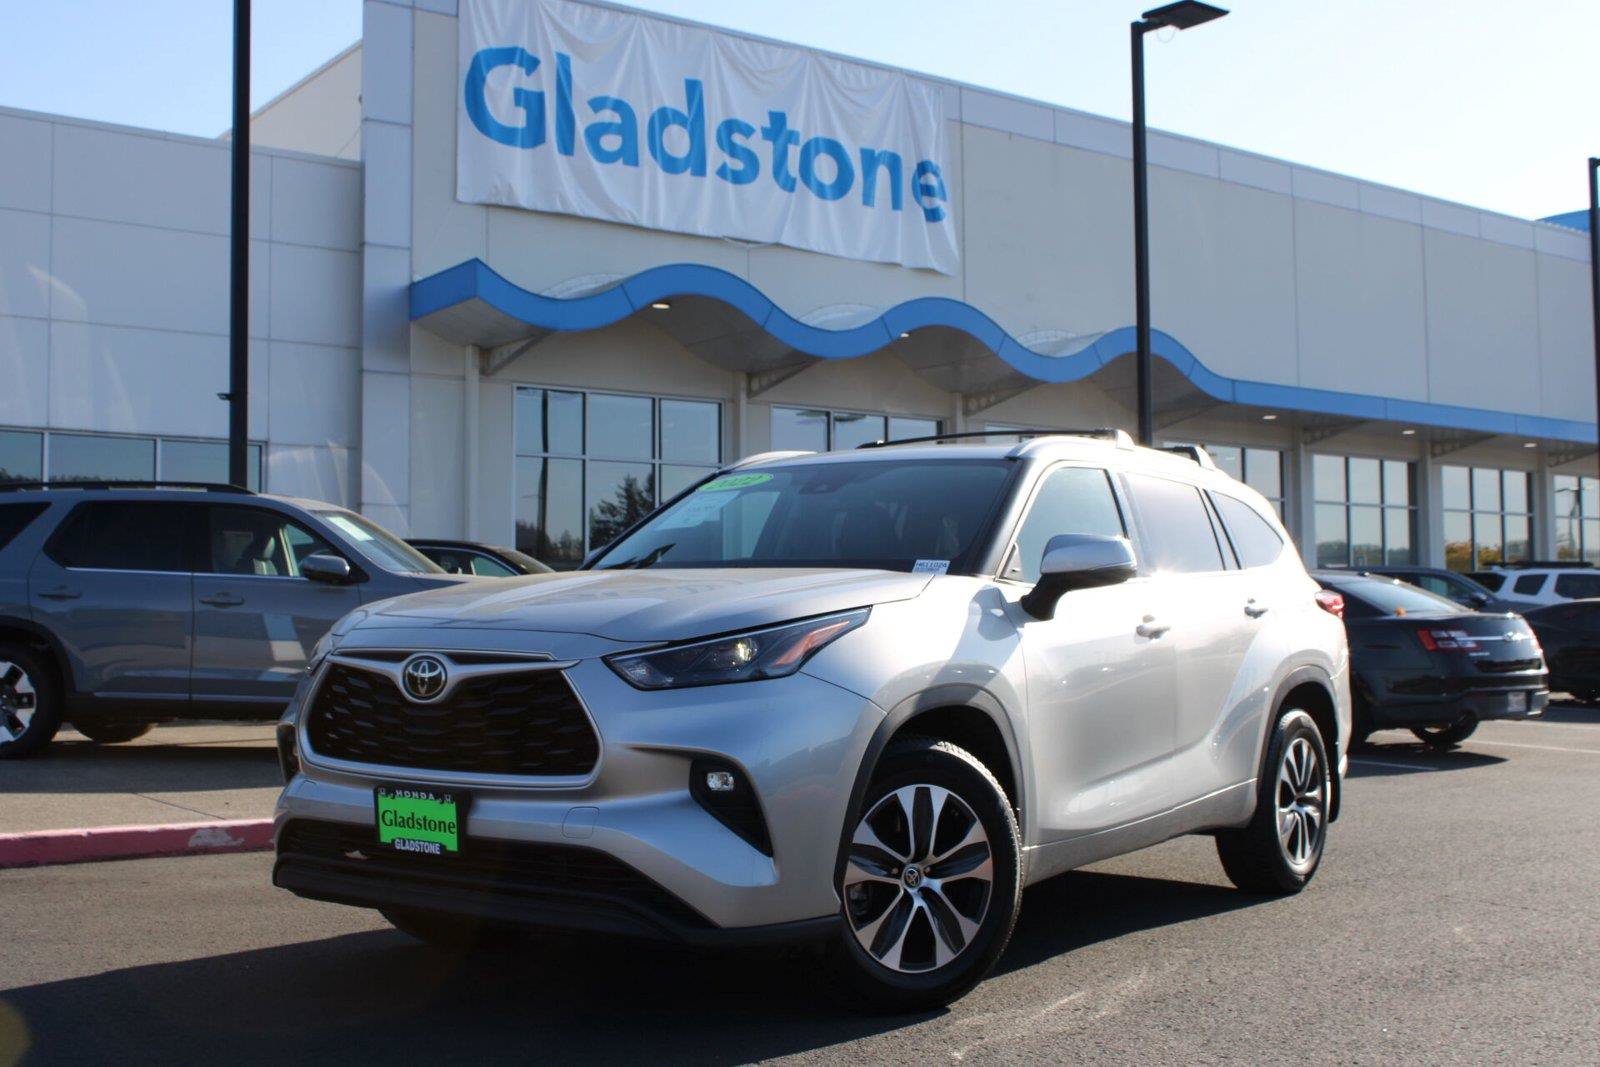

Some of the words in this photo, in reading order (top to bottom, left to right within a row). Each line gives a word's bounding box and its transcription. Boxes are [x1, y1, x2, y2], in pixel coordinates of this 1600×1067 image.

[464, 46, 949, 223] Gladstone
[395, 789, 435, 801] HONDA
[381, 809, 457, 835] Gladstone
[394, 838, 441, 855] GLADSTONE
